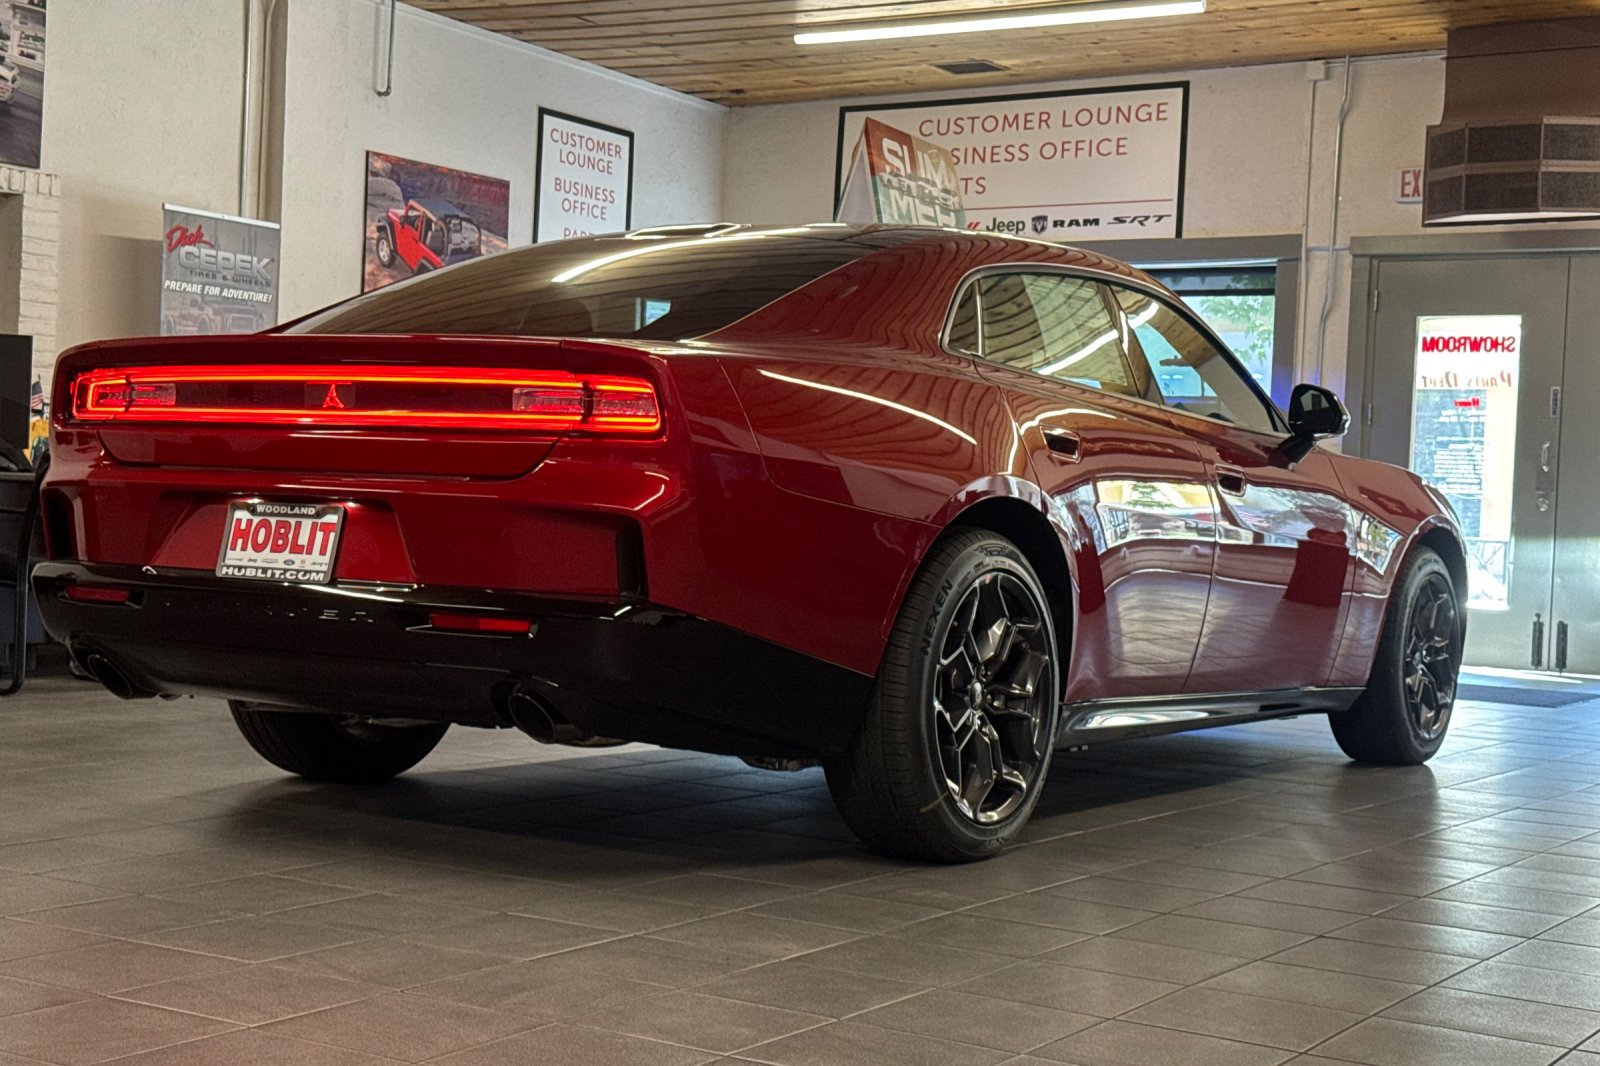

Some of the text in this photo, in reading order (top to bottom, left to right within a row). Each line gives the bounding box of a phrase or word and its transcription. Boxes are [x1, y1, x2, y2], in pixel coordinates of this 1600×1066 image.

[918, 102, 1168, 137] CUSTOMER LOUNGE
[550, 128, 622, 159] CUSTOMER
[951, 137, 1128, 166] SINESS OFFICE
[559, 148, 613, 175] LOUNGE
[554, 177, 615, 204] BUSINESS
[1401, 169, 1422, 198] EX
[561, 198, 607, 221] OFFICE
[986, 214, 1172, 234] Jeep RAM SRT
[166, 224, 215, 253] Dick
[180, 245, 273, 281] CEPEK
[164, 280, 273, 303] PREPARE FOR ADVENTURE!
[256, 505, 316, 515] WOODLAND
[230, 518, 337, 556] HOBLIT
[921, 578, 954, 656] NEXEN
